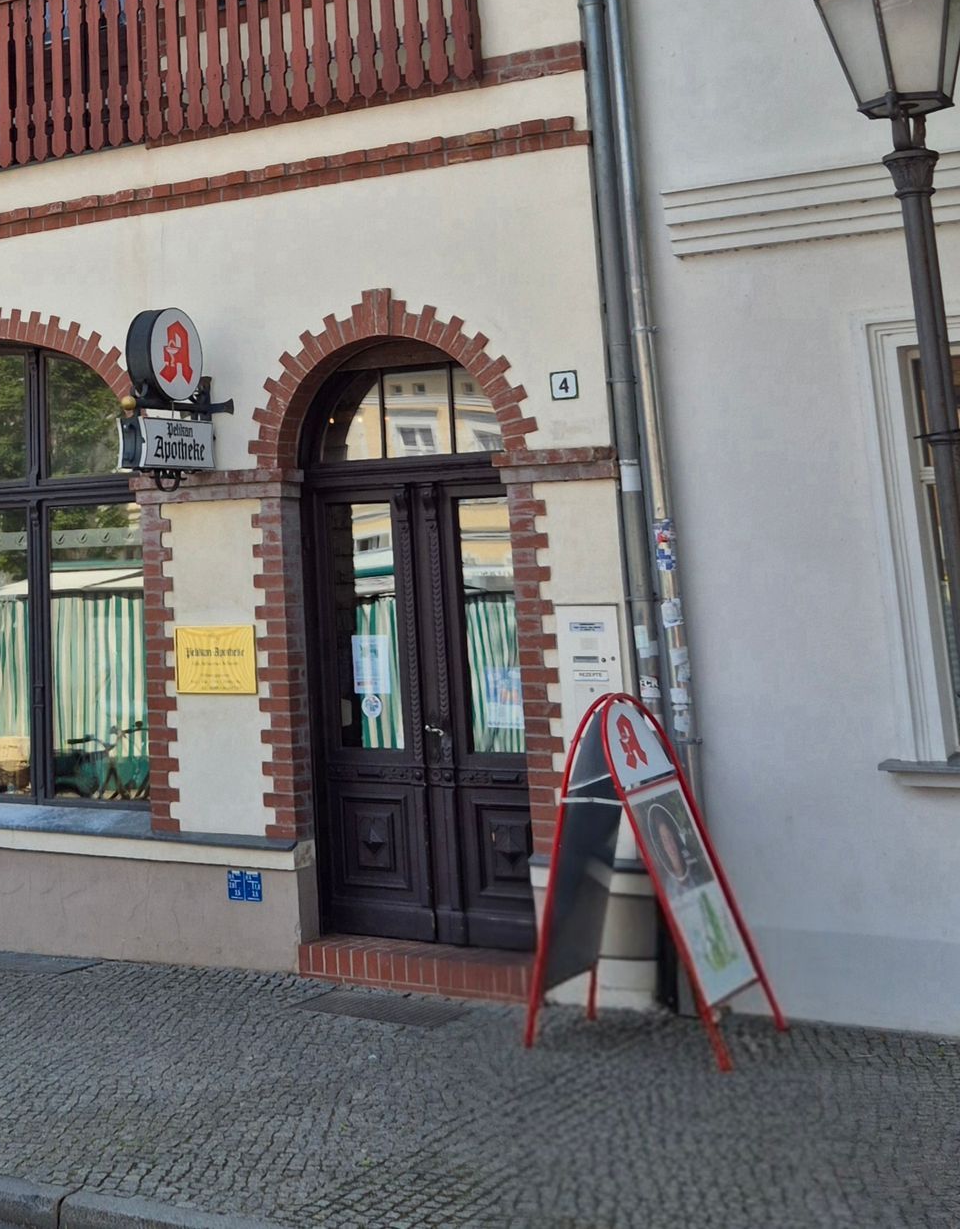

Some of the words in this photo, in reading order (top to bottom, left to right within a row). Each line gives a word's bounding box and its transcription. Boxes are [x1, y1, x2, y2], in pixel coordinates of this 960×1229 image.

[558, 377, 569, 394] 4
[166, 422, 194, 438] Pelikan
[153, 435, 206, 463] Apotheke
